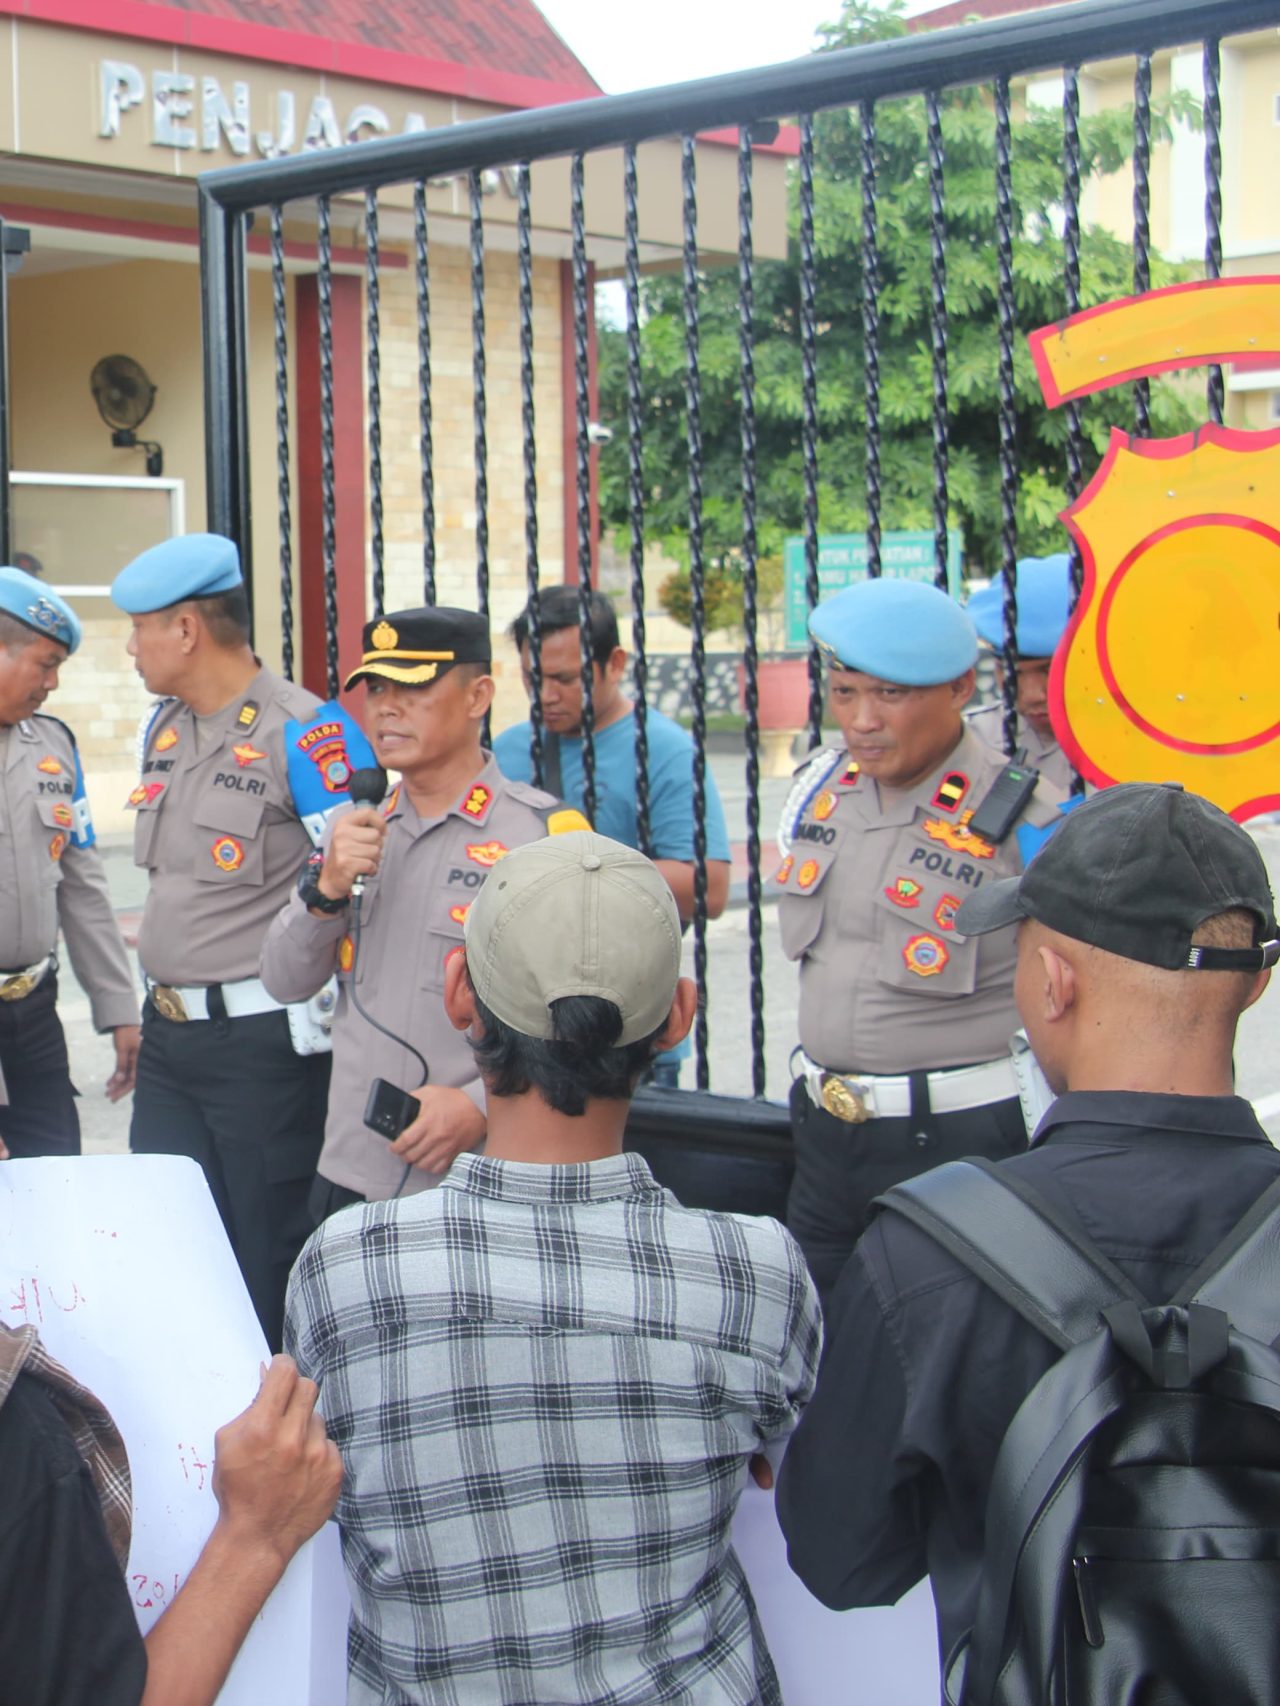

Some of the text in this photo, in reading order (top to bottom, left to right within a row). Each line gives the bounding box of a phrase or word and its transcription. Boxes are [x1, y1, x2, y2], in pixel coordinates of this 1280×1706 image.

[300, 724, 339, 748] POLDA
[213, 772, 267, 797] POLRI
[909, 848, 984, 888] POLRI
